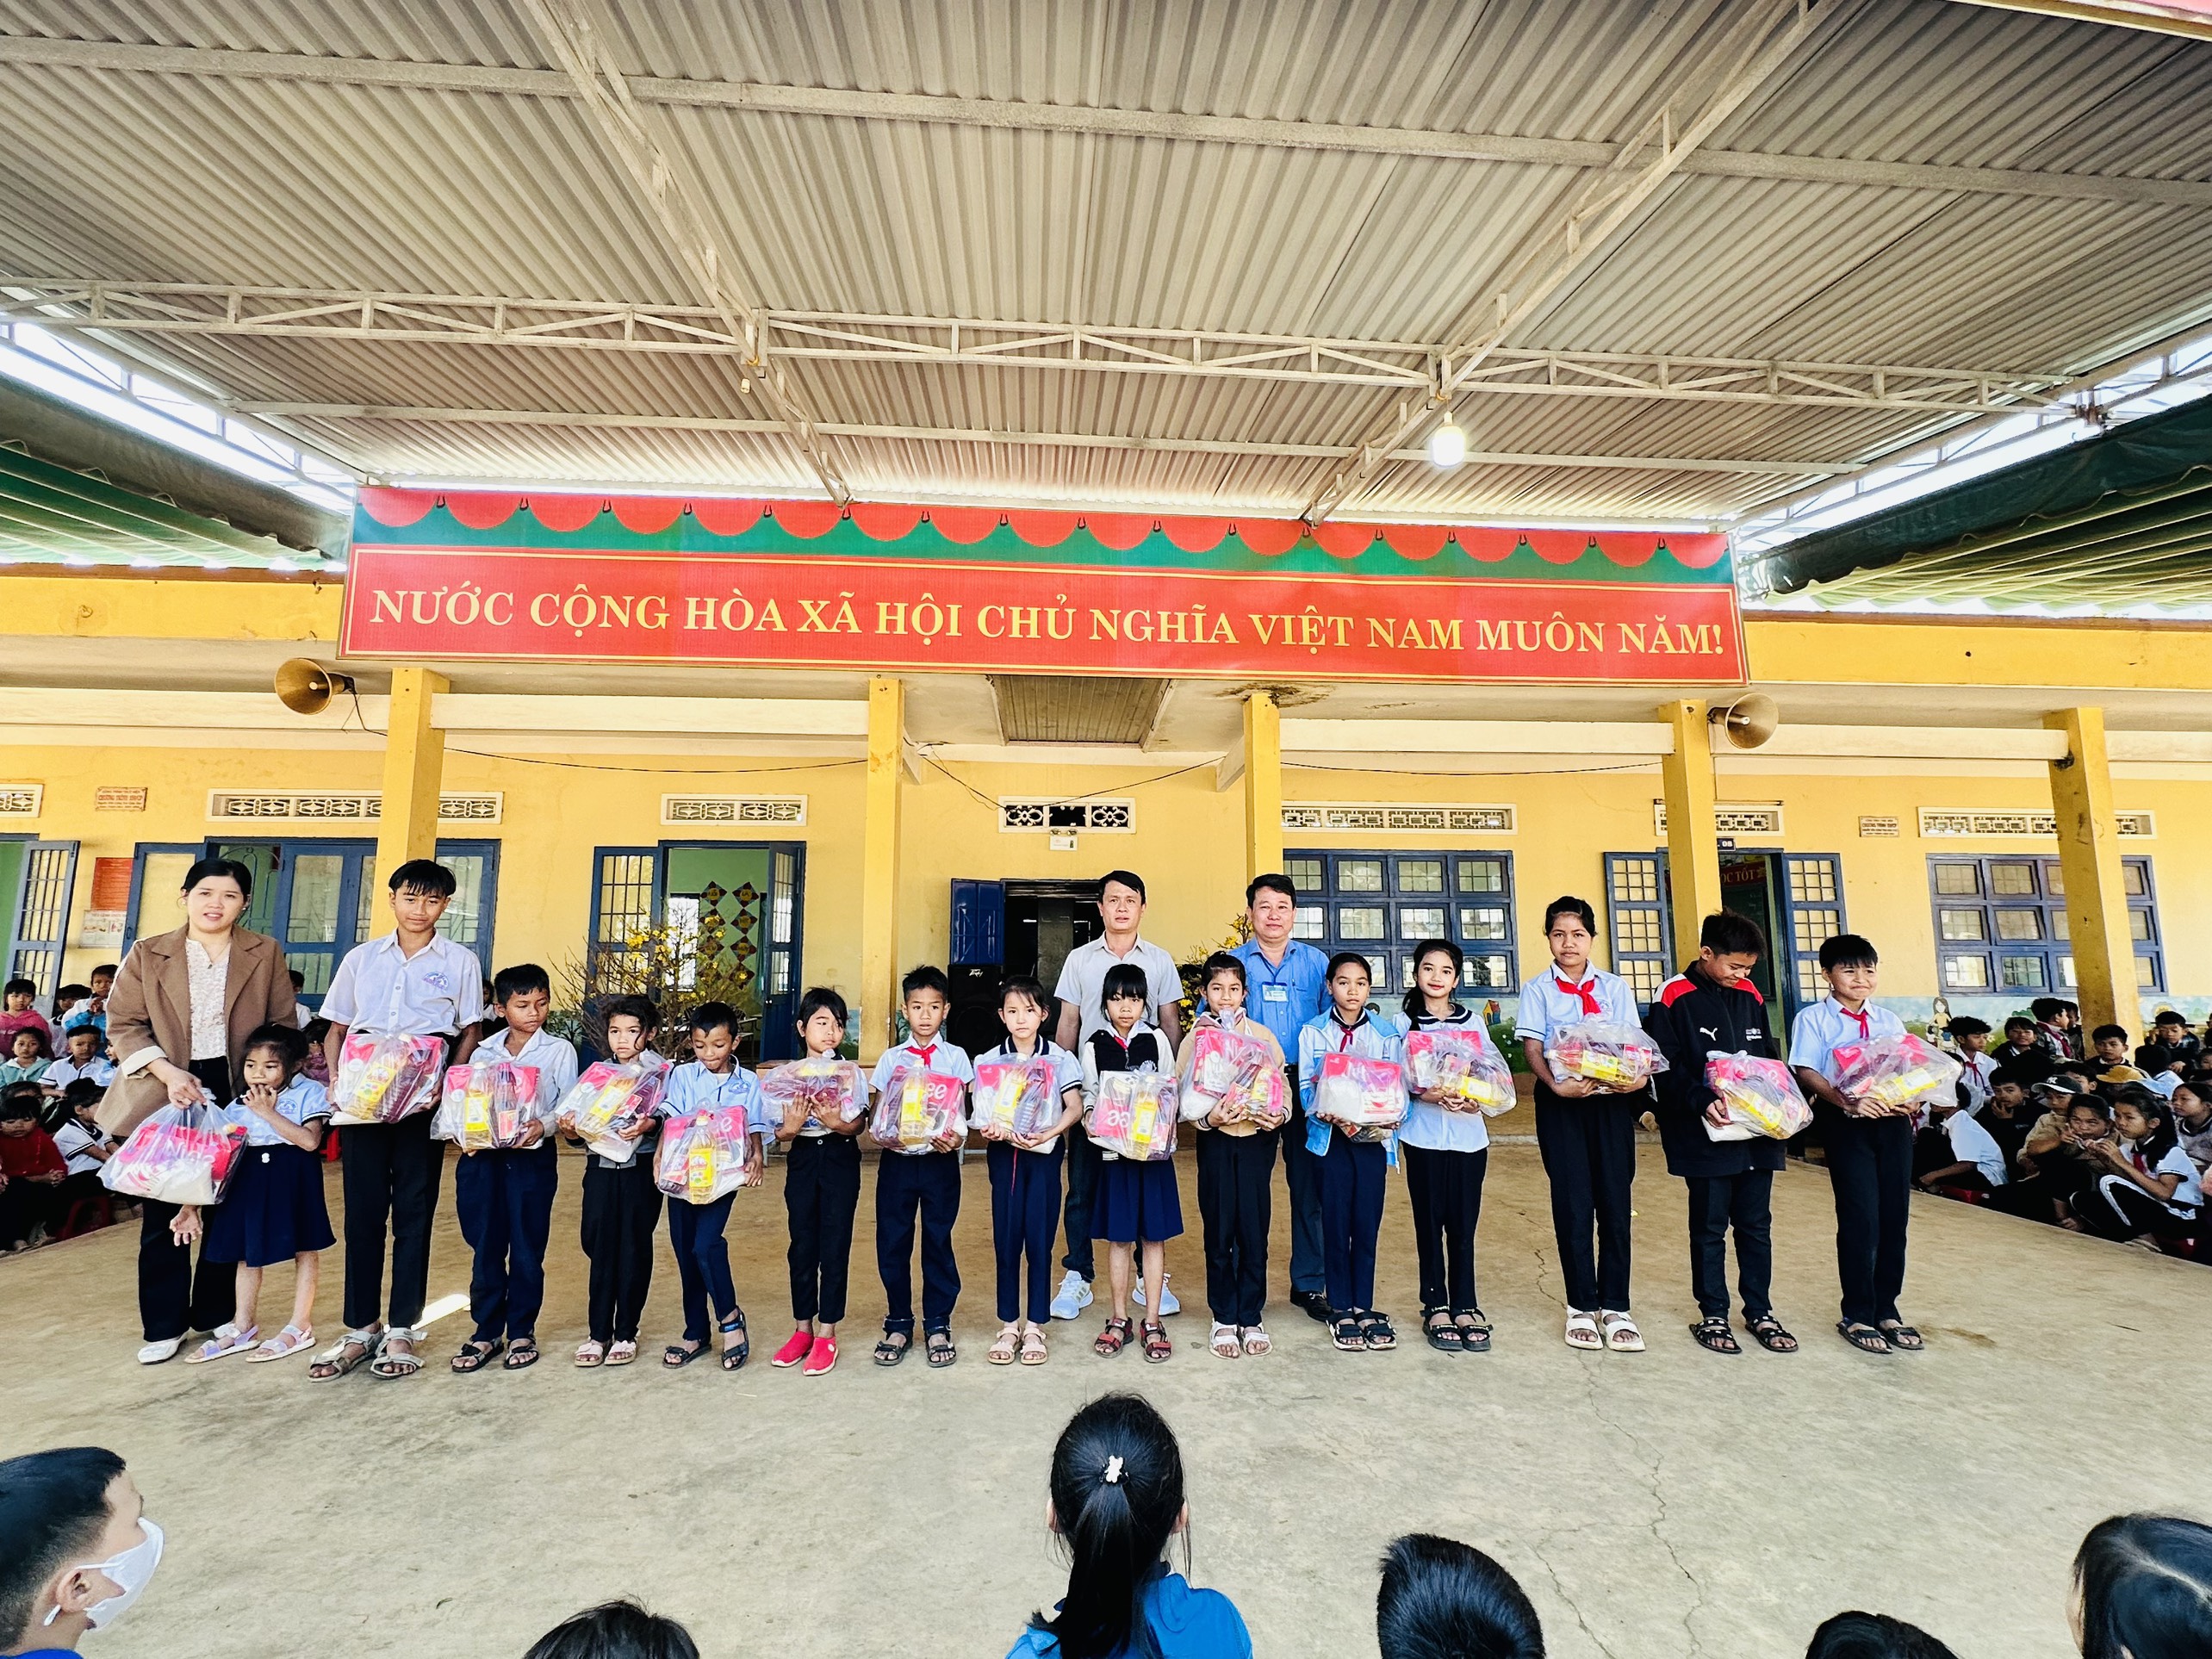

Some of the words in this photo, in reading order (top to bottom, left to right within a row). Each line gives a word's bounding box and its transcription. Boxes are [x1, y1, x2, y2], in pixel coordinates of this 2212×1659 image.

[370, 579, 513, 625] NƯỚC
[530, 583, 669, 638] CỘNG
[683, 587, 788, 632] HÒA
[797, 591, 862, 634] XÃ
[874, 592, 962, 646] HỘI
[977, 593, 1077, 639] CHỦ
[1088, 603, 1239, 644] NGHĨA
[1248, 605, 1355, 655] VIỆT
[1365, 618, 1464, 651] NAM
[1475, 611, 1605, 653] MUÔN
[1616, 614, 1724, 655] NĂM!
